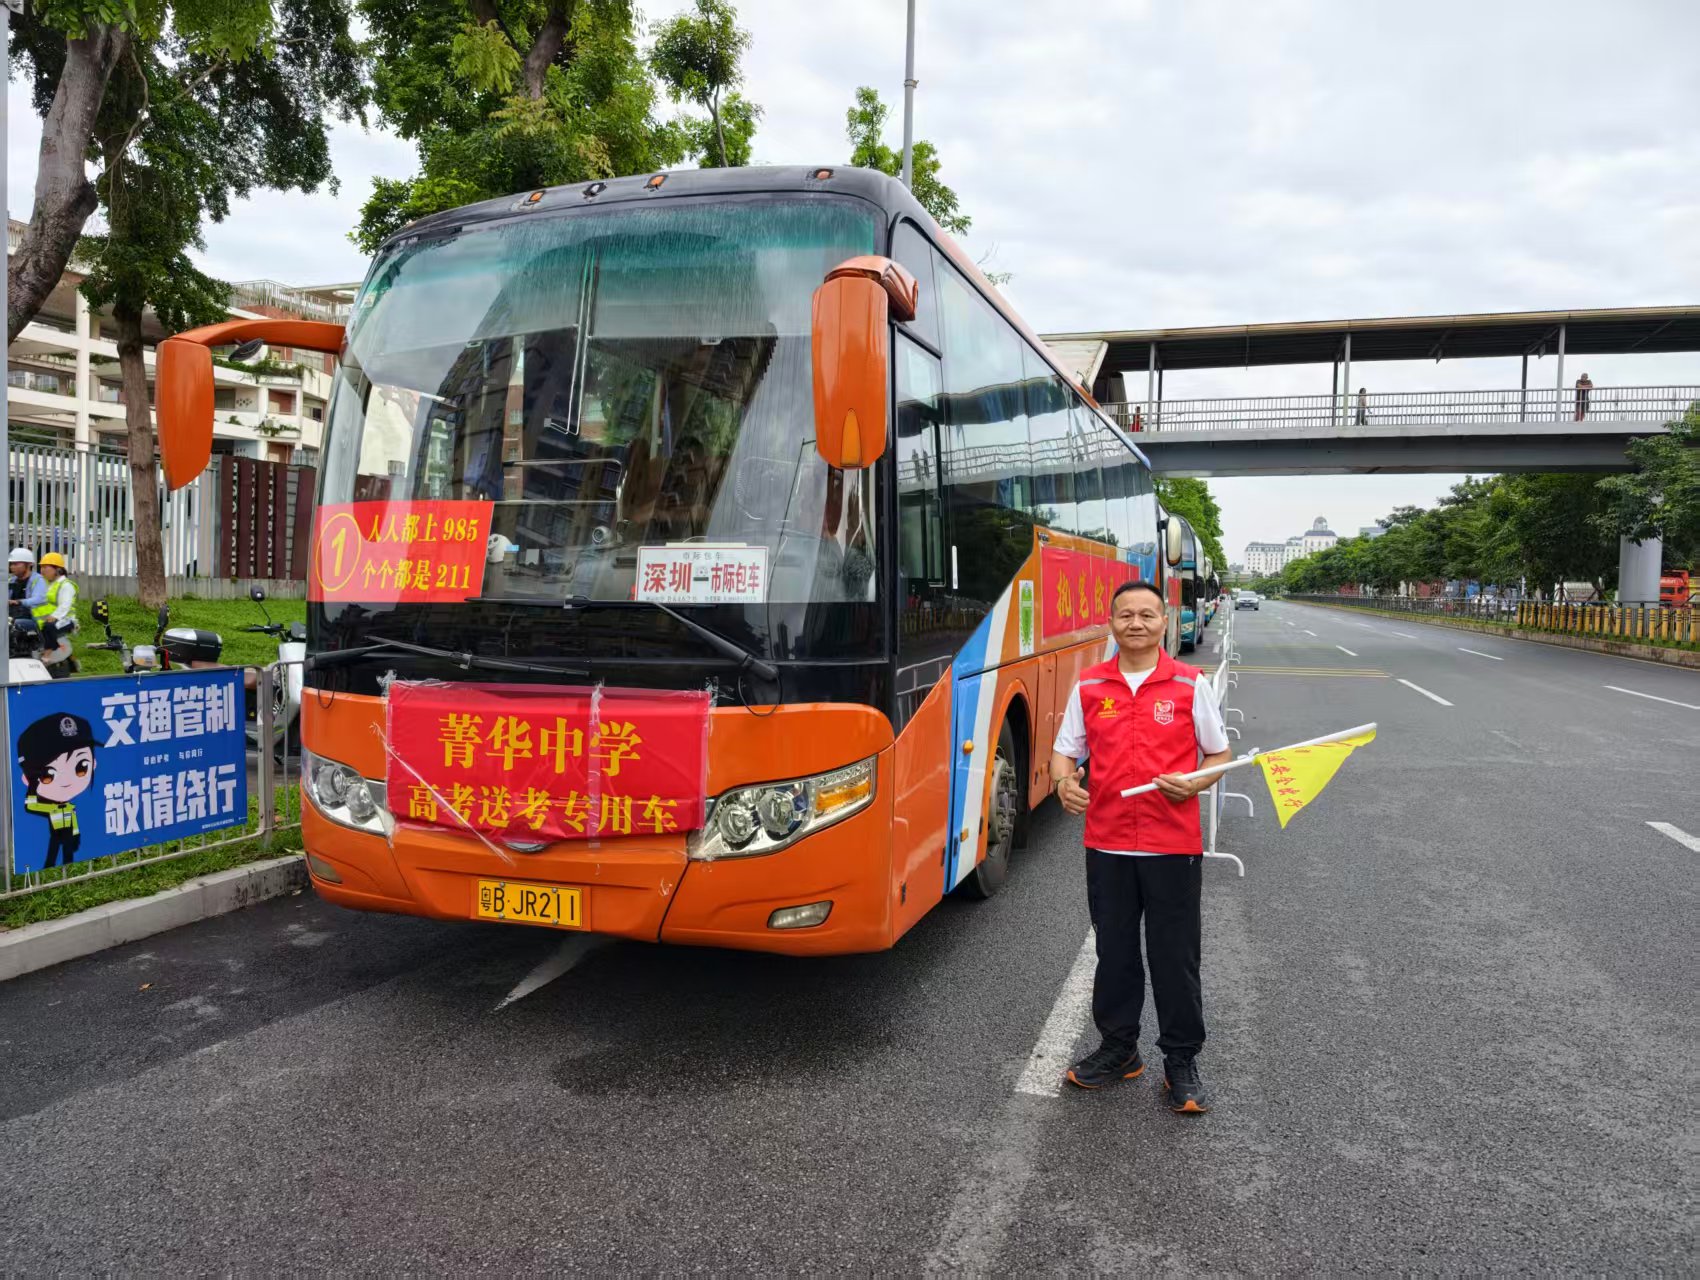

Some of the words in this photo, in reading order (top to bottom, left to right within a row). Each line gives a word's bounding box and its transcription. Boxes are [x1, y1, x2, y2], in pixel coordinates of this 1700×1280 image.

[101, 682, 236, 748] 交通管制
[438, 713, 643, 777] 菁华中学
[104, 763, 237, 836] 敬请绕行
[408, 780, 679, 835] 高考送考专用车
